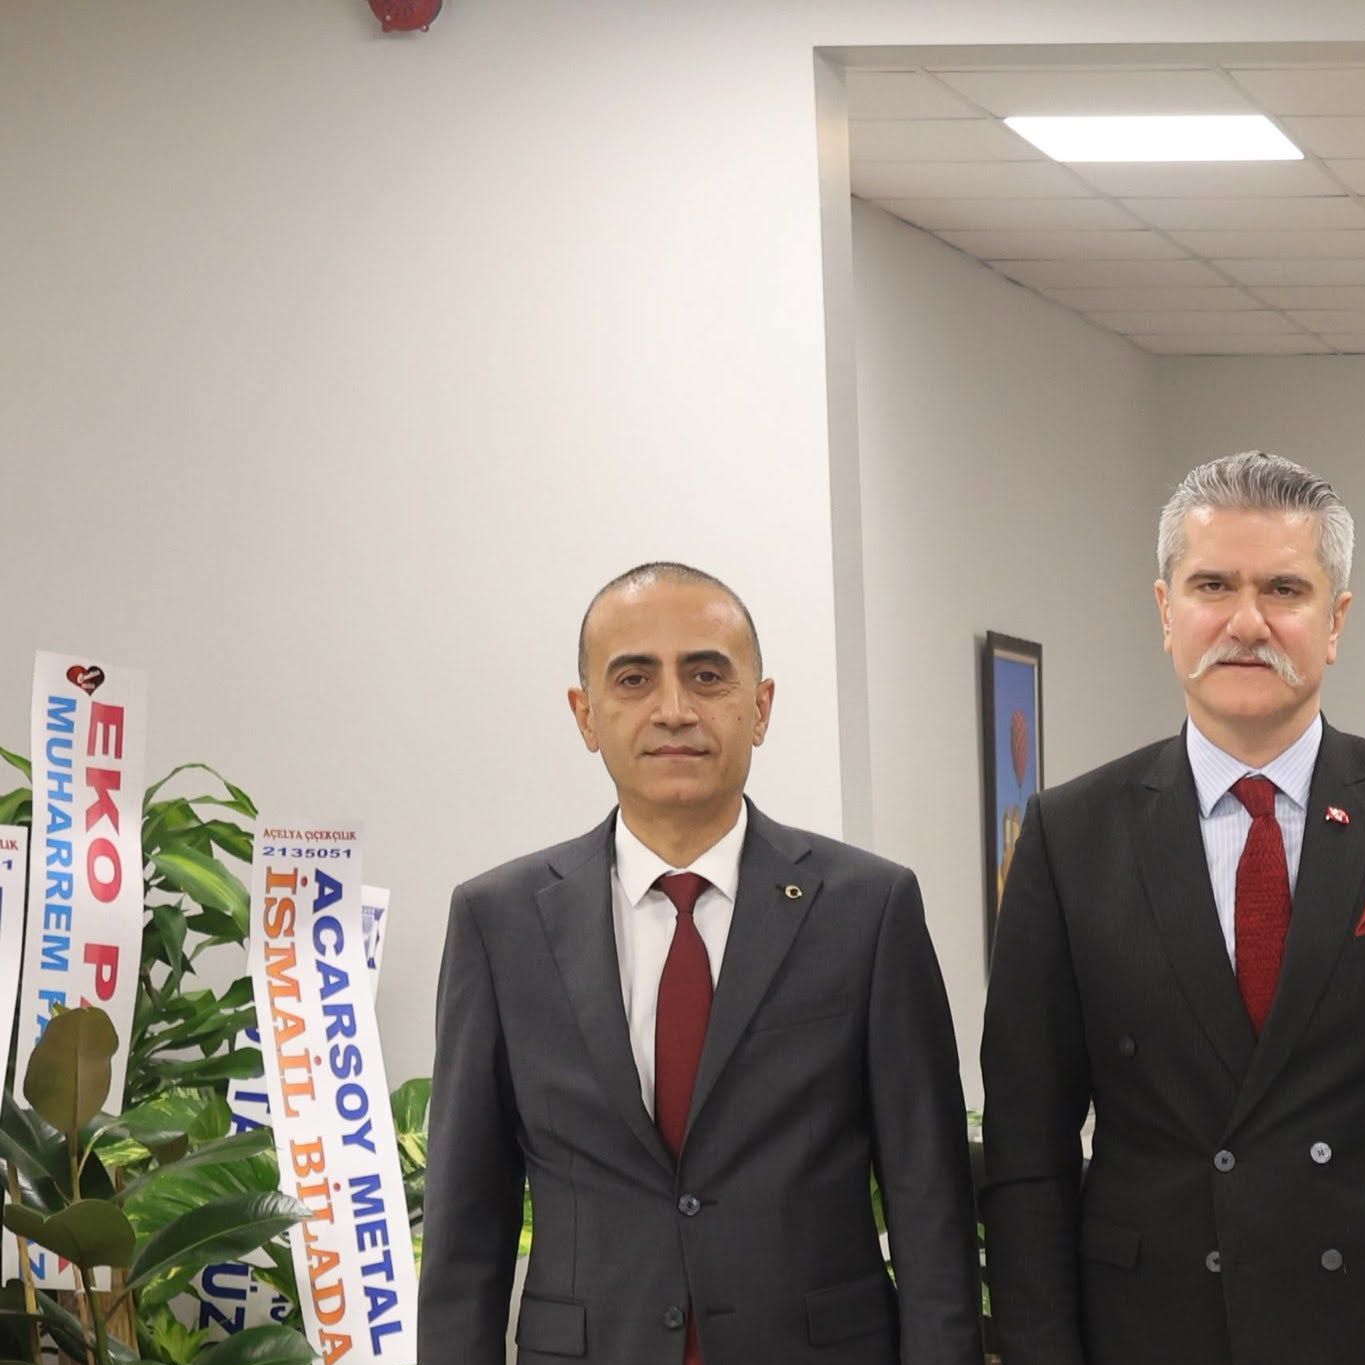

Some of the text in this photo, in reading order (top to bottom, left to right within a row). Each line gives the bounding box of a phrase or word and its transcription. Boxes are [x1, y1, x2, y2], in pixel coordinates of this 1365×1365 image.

[40, 696, 78, 972] MUHARREM
[84, 701, 125, 905] EKO
[262, 846, 352, 859] 2135051
[263, 828, 305, 841] AÇELYA
[263, 866, 323, 1118] İSMAİL
[312, 868, 403, 1357] ACARSOY METAL
